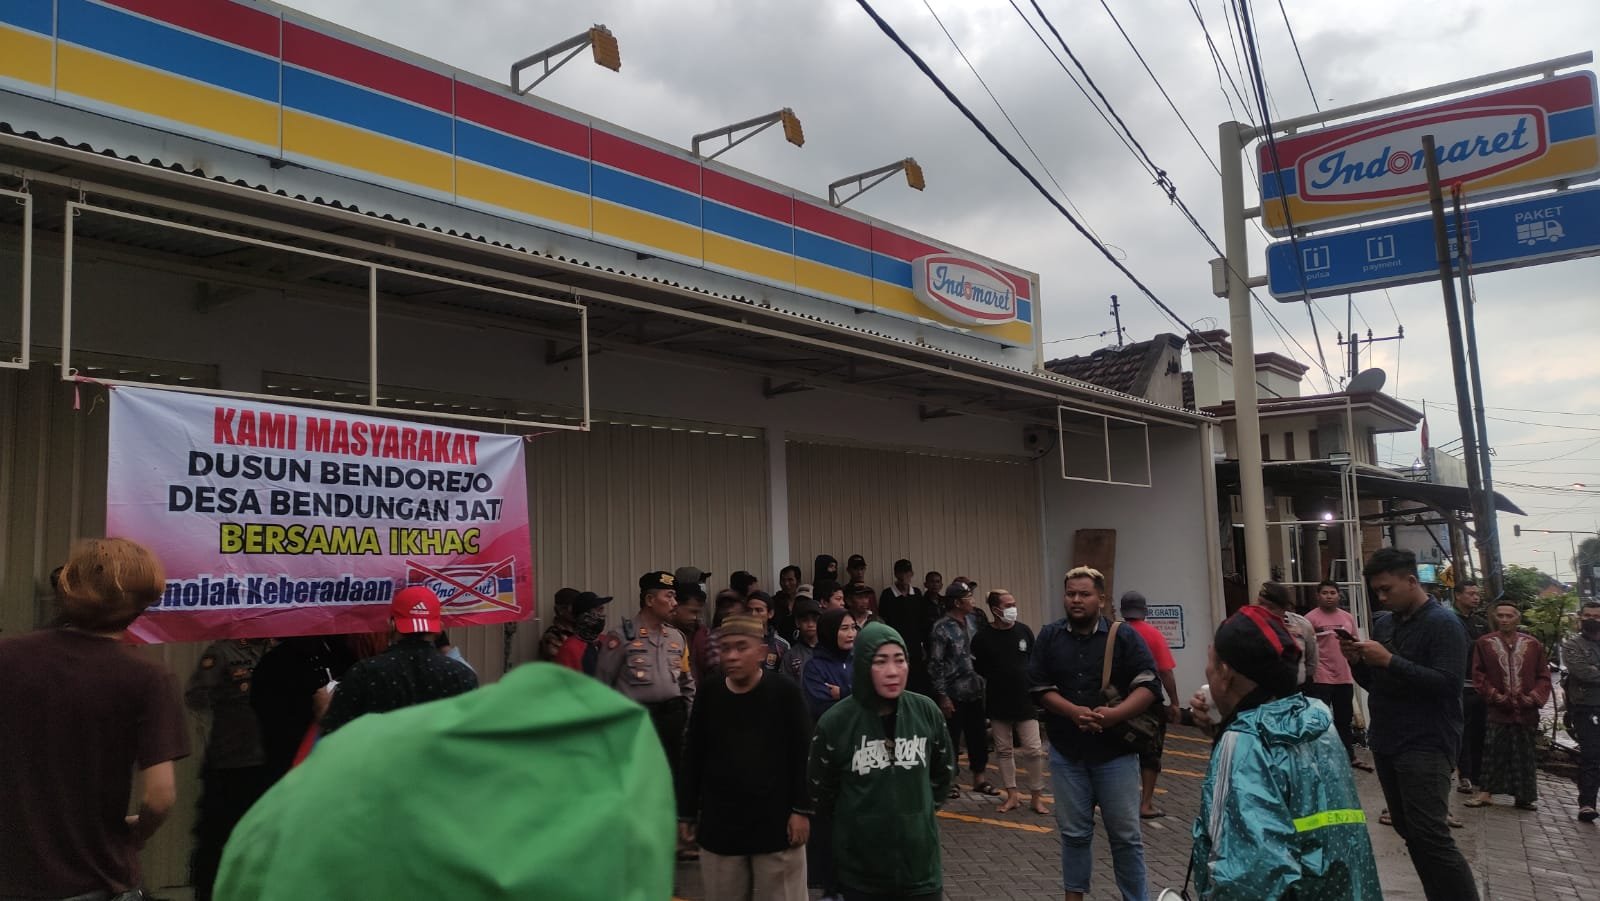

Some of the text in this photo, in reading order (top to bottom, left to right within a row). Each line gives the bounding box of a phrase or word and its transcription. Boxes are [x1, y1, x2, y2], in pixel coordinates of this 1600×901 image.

[1311, 118, 1528, 189] Indomaret
[1514, 206, 1564, 222] PAKET
[1306, 270, 1330, 281] pulsa
[1362, 258, 1402, 272] payment
[933, 266, 1011, 311] Indomaret
[214, 407, 480, 465] KAMI MASYARAKAT
[188, 451, 493, 493] DUSUN BENDOREJO
[168, 484, 263, 516] DESA
[270, 490, 449, 521] BENDUNGAN
[219, 522, 481, 555] BERSAMA IKHAC
[246, 577, 393, 606] Keberadaan
[1154, 608, 1179, 617] GRATIS
